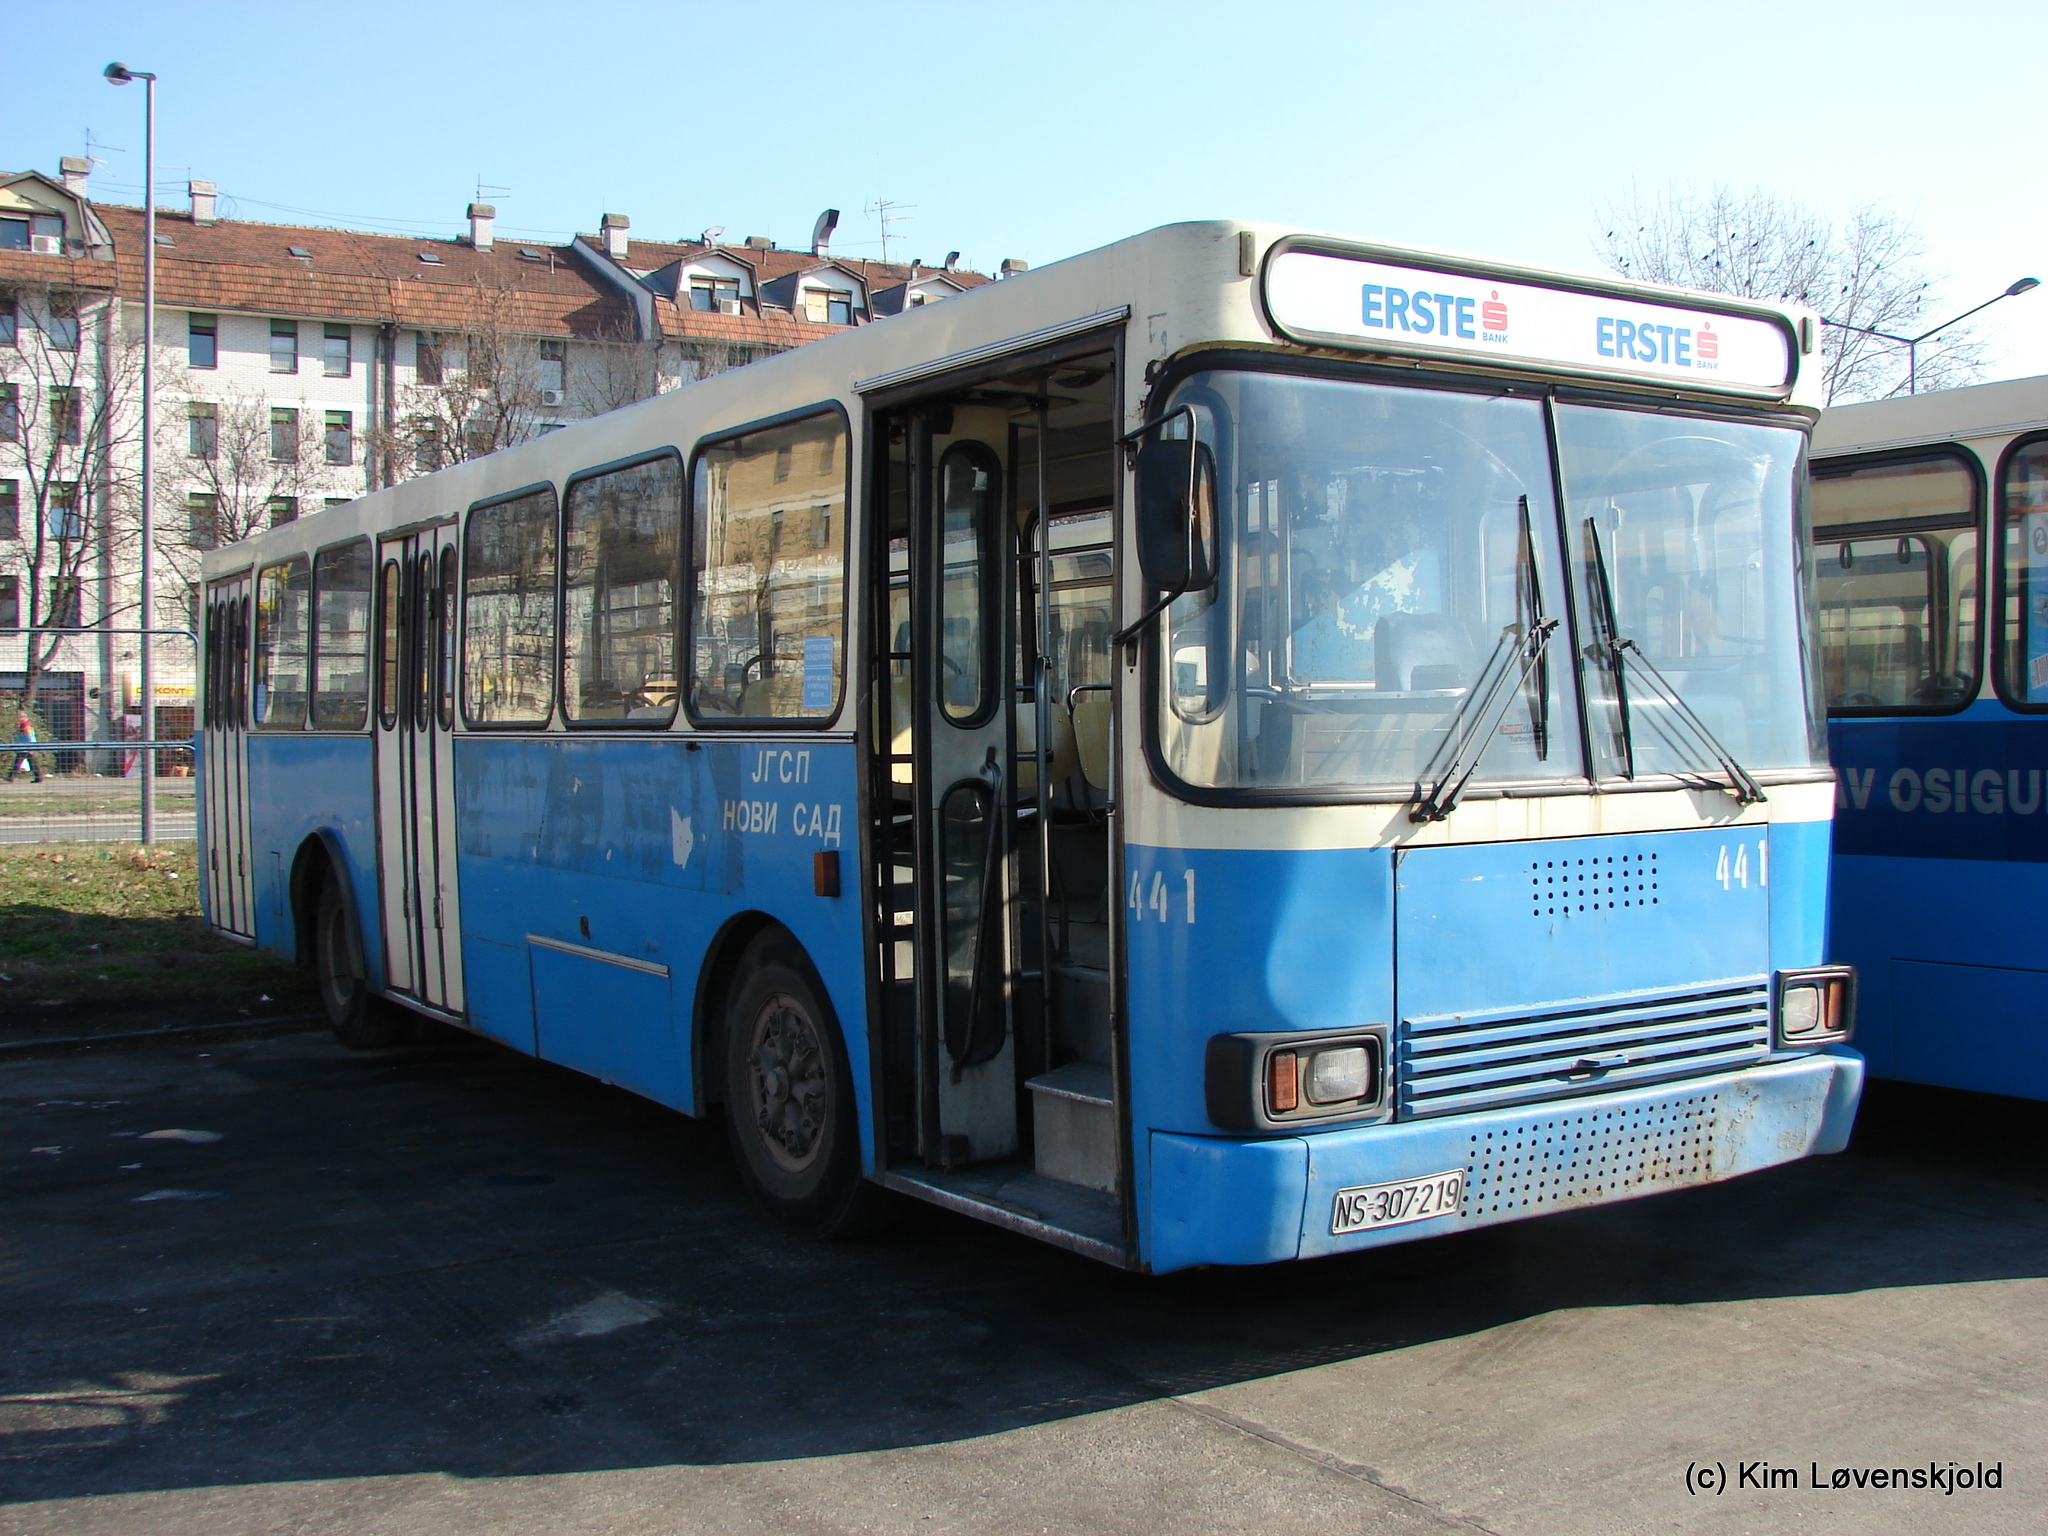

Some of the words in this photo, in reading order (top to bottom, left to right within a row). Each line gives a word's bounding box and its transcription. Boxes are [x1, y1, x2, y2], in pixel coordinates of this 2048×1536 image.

[1361, 283, 1475, 339] ERSTE
[1482, 332, 1508, 344] BANK
[1596, 316, 1691, 367] ERSTE
[1696, 360, 1719, 371] BANK
[1889, 767, 2048, 815] OSIGU
[723, 799, 778, 834] НОВИ
[793, 803, 841, 848] САД
[1715, 839, 1766, 891] 441
[1129, 868, 1196, 924] 441
